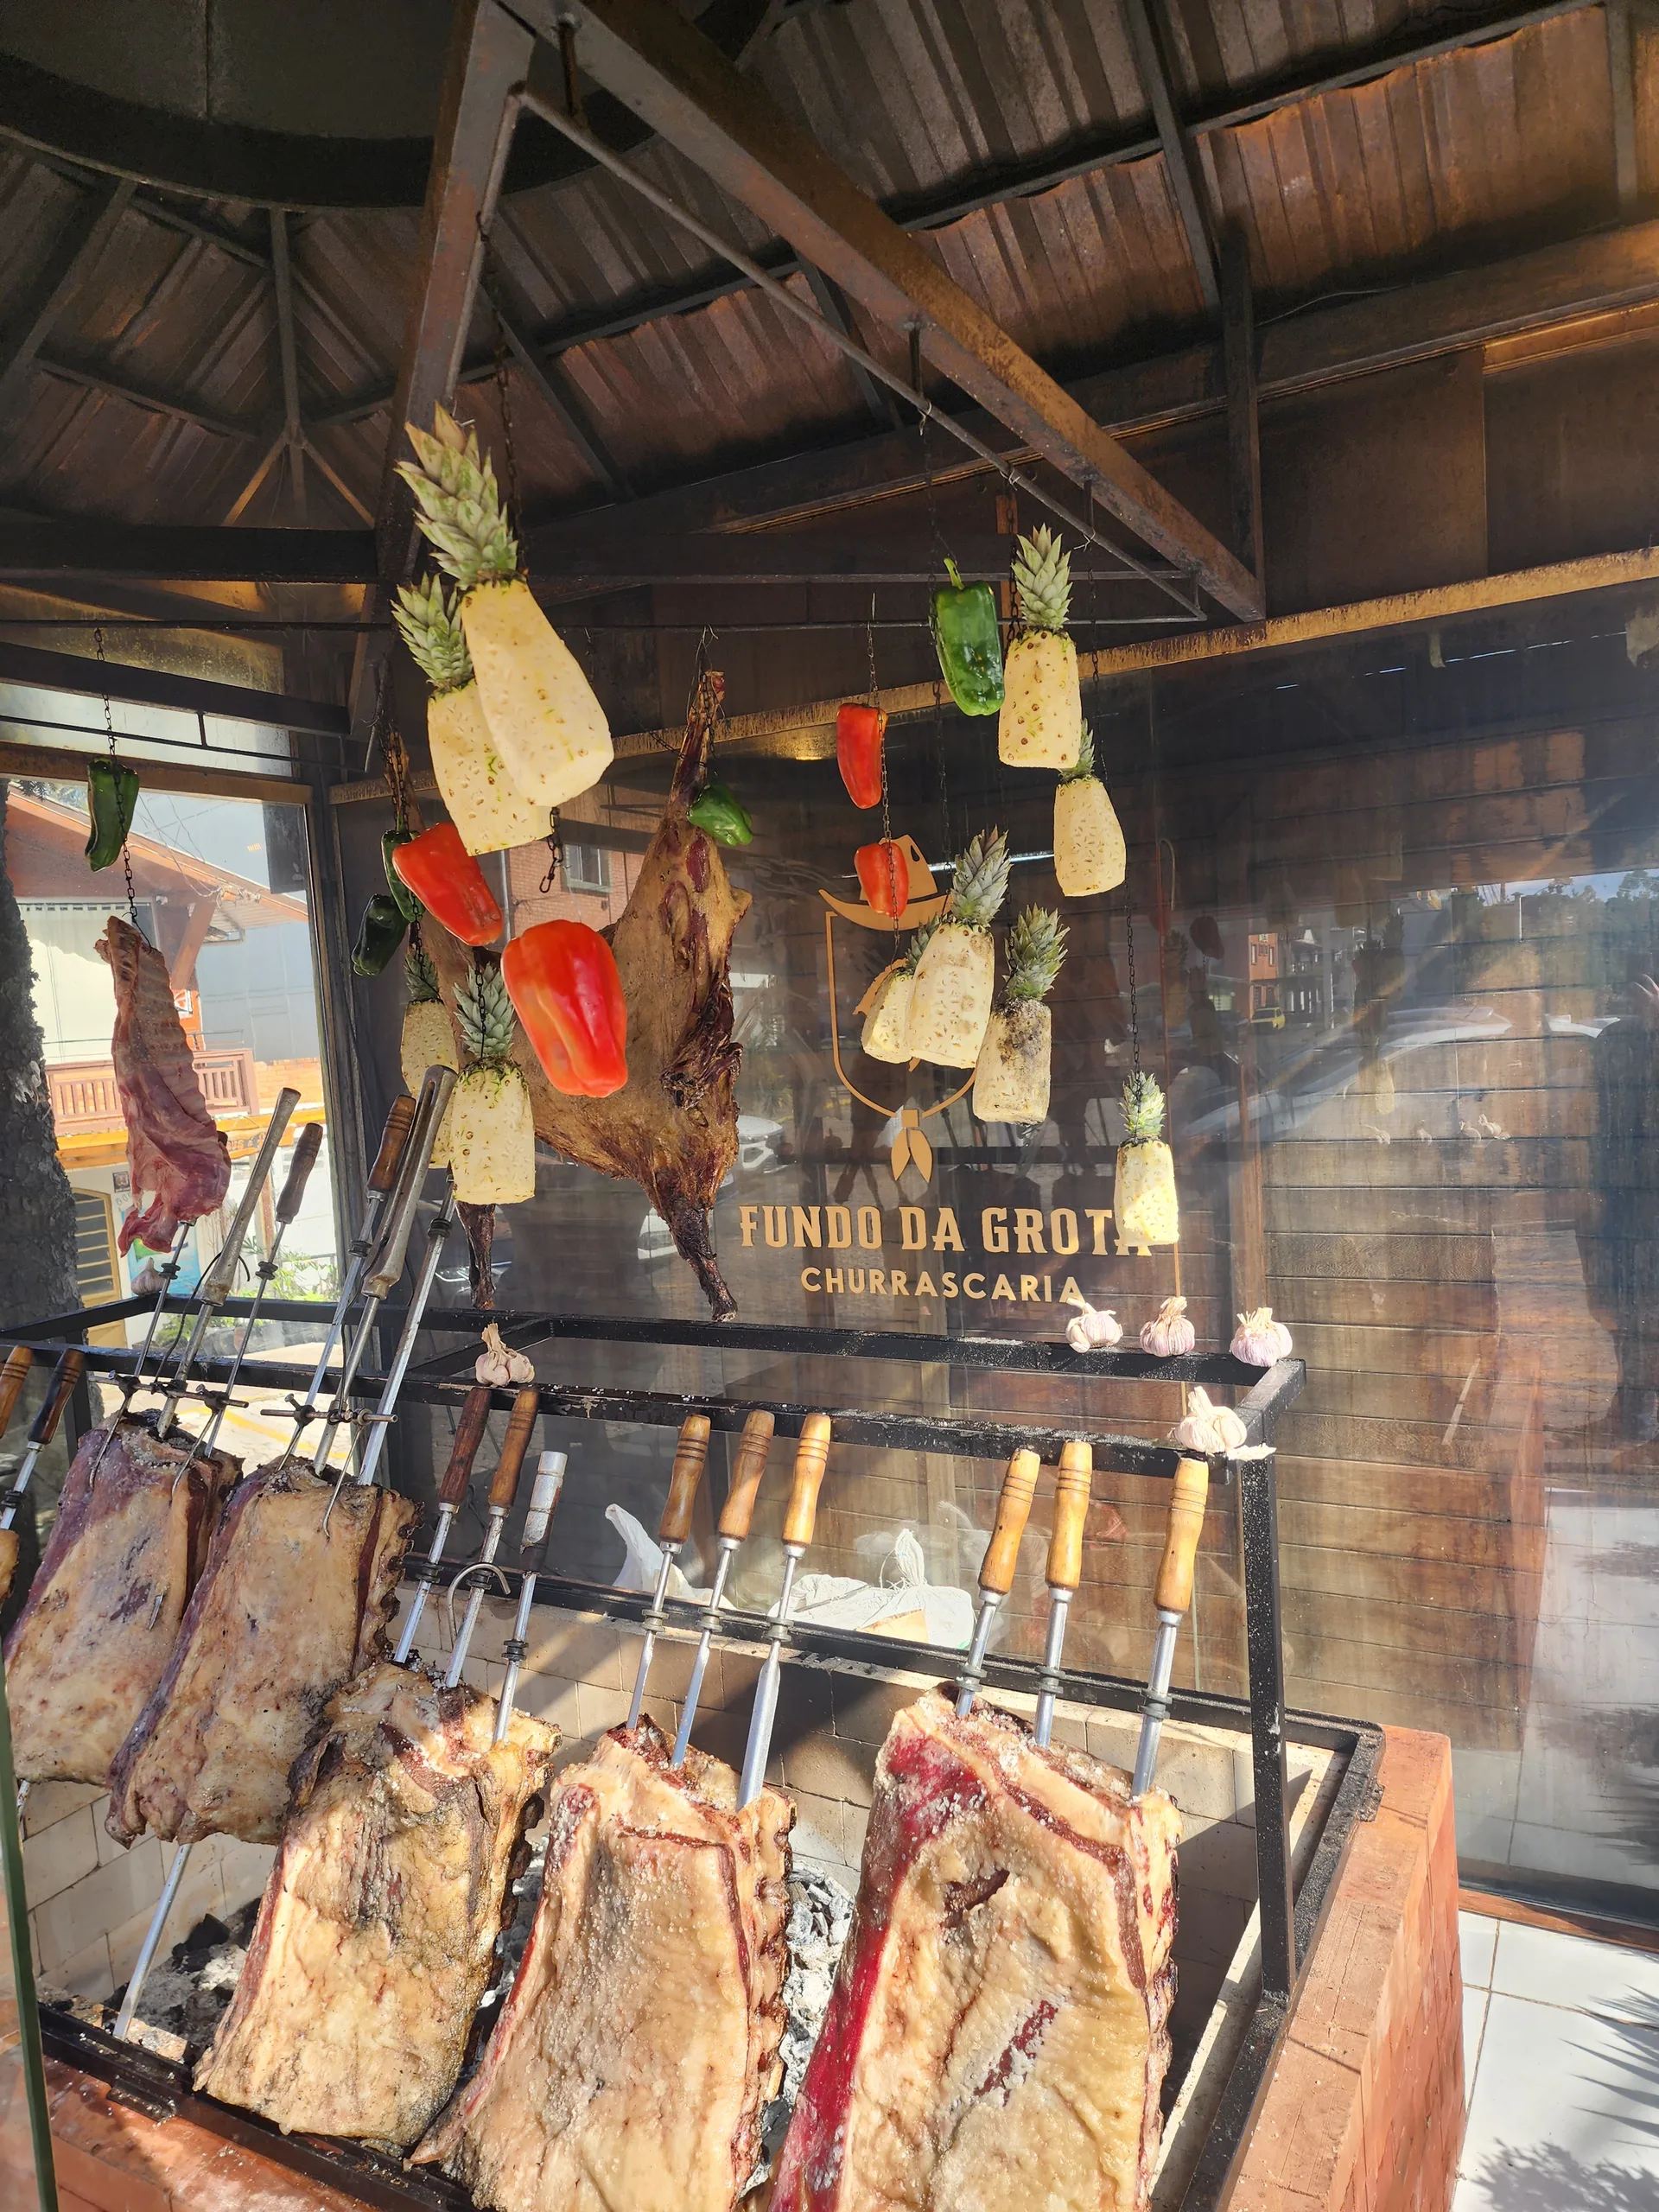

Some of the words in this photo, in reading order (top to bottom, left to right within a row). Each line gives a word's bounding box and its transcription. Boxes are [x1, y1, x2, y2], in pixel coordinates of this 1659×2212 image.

[739, 1205, 882, 1249] FUNDO
[899, 1206, 966, 1253] DA
[982, 1206, 1153, 1256] GROT
[800, 1266, 1085, 1304] CHURRASCARIA
